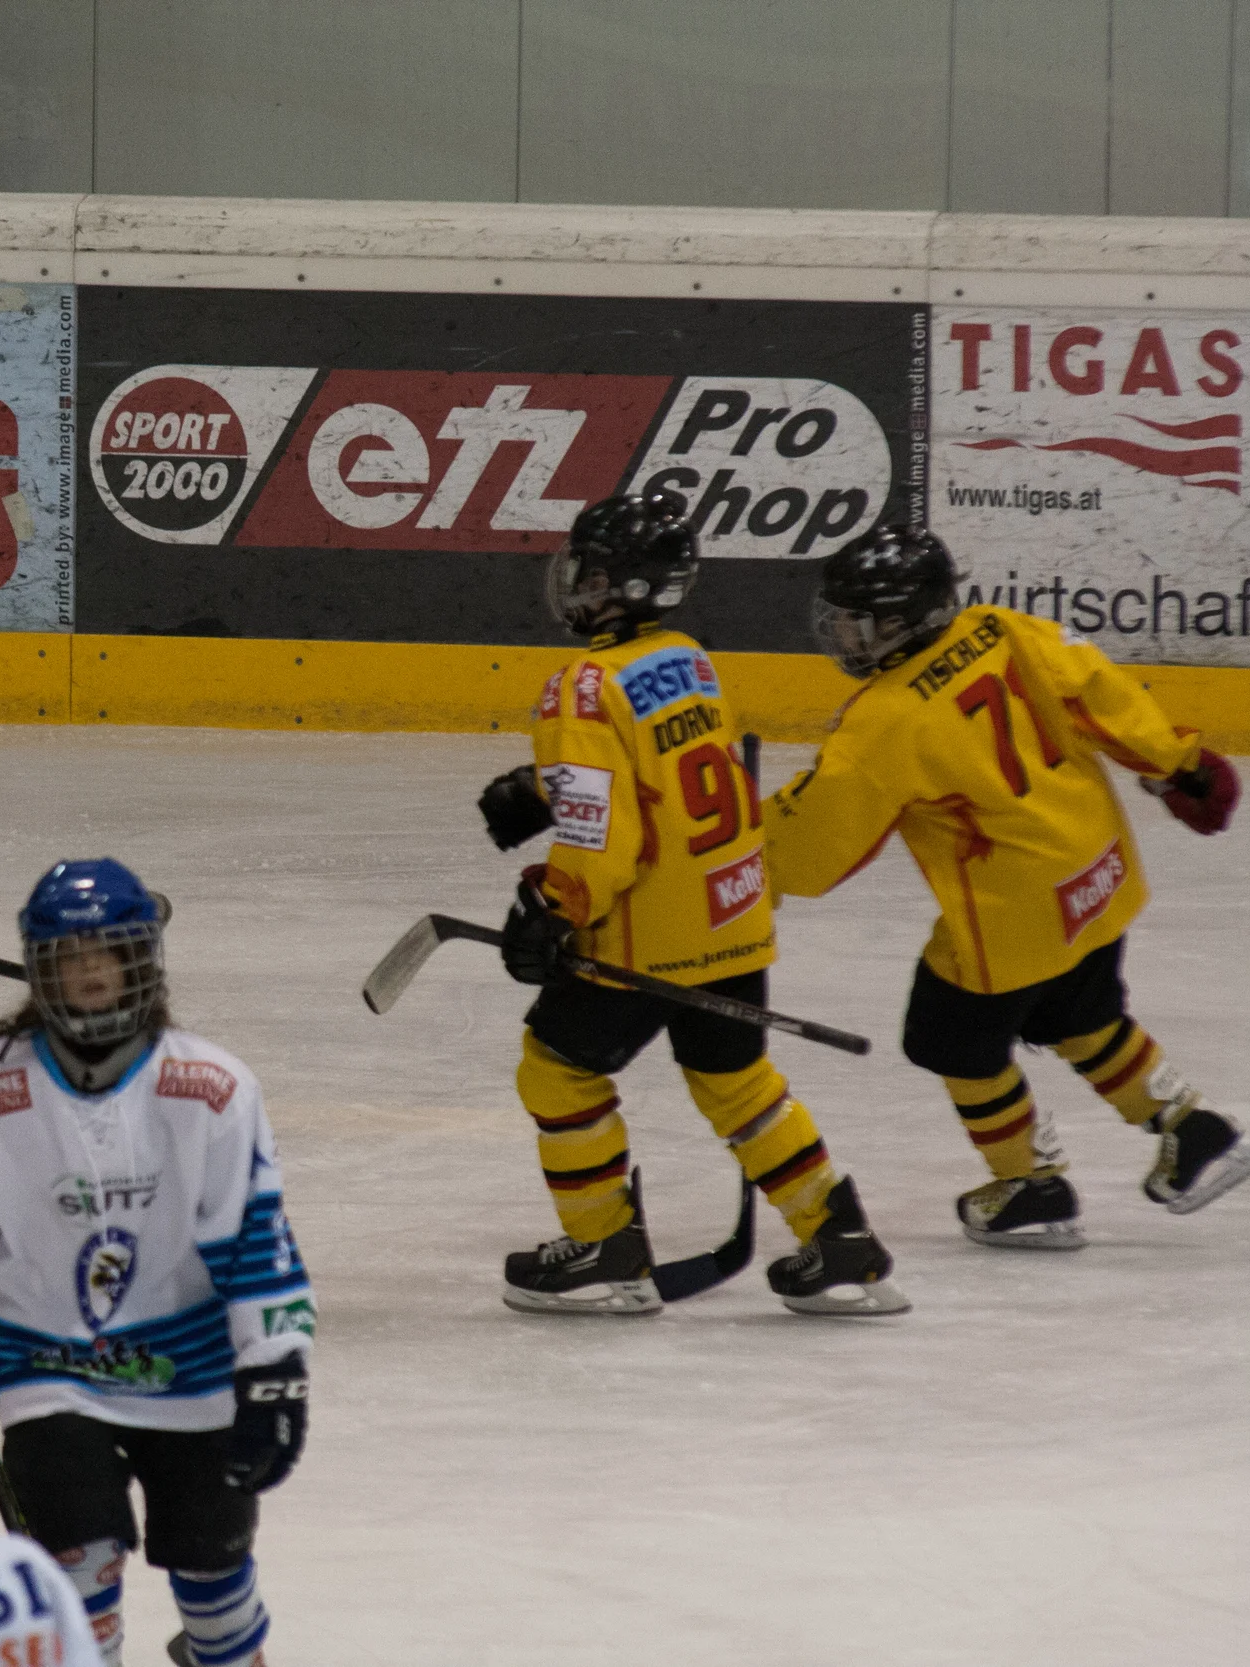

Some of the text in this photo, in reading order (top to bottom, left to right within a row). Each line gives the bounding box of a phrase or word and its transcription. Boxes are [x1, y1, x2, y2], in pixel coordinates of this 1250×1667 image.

[950, 323, 1243, 399] TIGAS
[109, 411, 231, 451] SPORT
[668, 388, 837, 459] Pro
[123, 460, 229, 501] 2000
[643, 467, 869, 555] Shop
[949, 480, 1102, 515] www.tigas.at
[56, 560, 73, 627] printed
[623, 656, 695, 716] ERST
[907, 613, 1005, 701] TISCHLER
[955, 657, 1065, 798] 71
